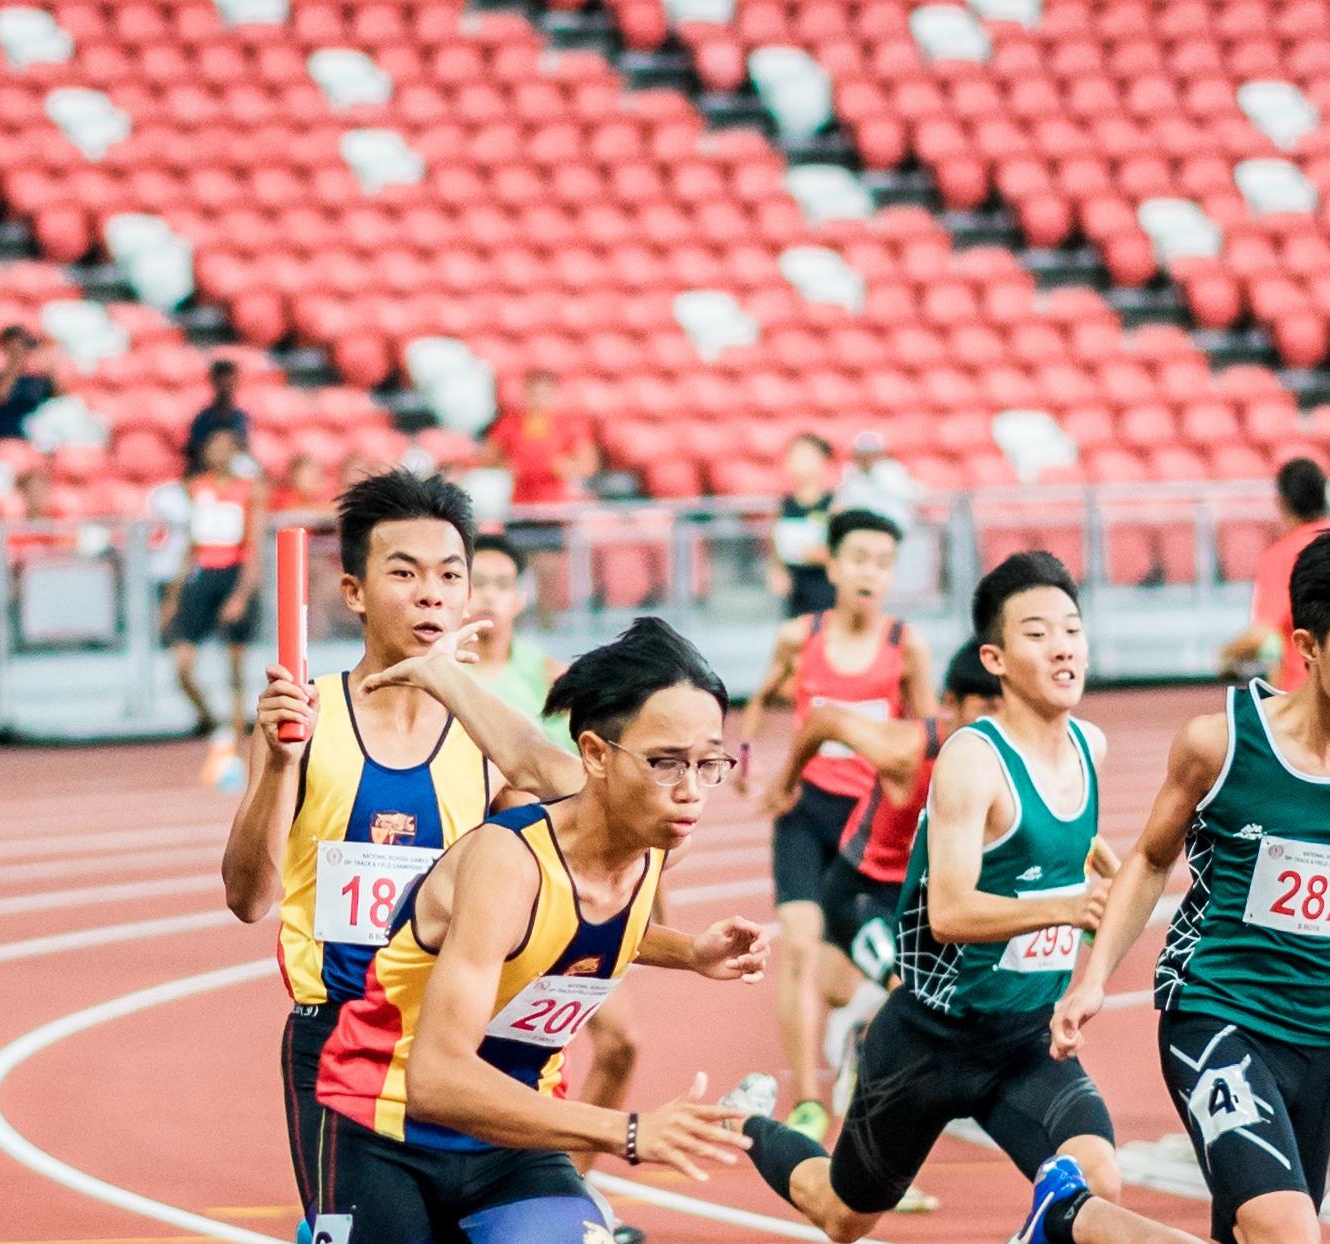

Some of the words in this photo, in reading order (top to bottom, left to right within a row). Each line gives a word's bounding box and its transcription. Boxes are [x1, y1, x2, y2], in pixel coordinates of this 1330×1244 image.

[342, 876, 396, 928] 18
[1023, 926, 1073, 957] 293
[1208, 1078, 1239, 1117] 4
